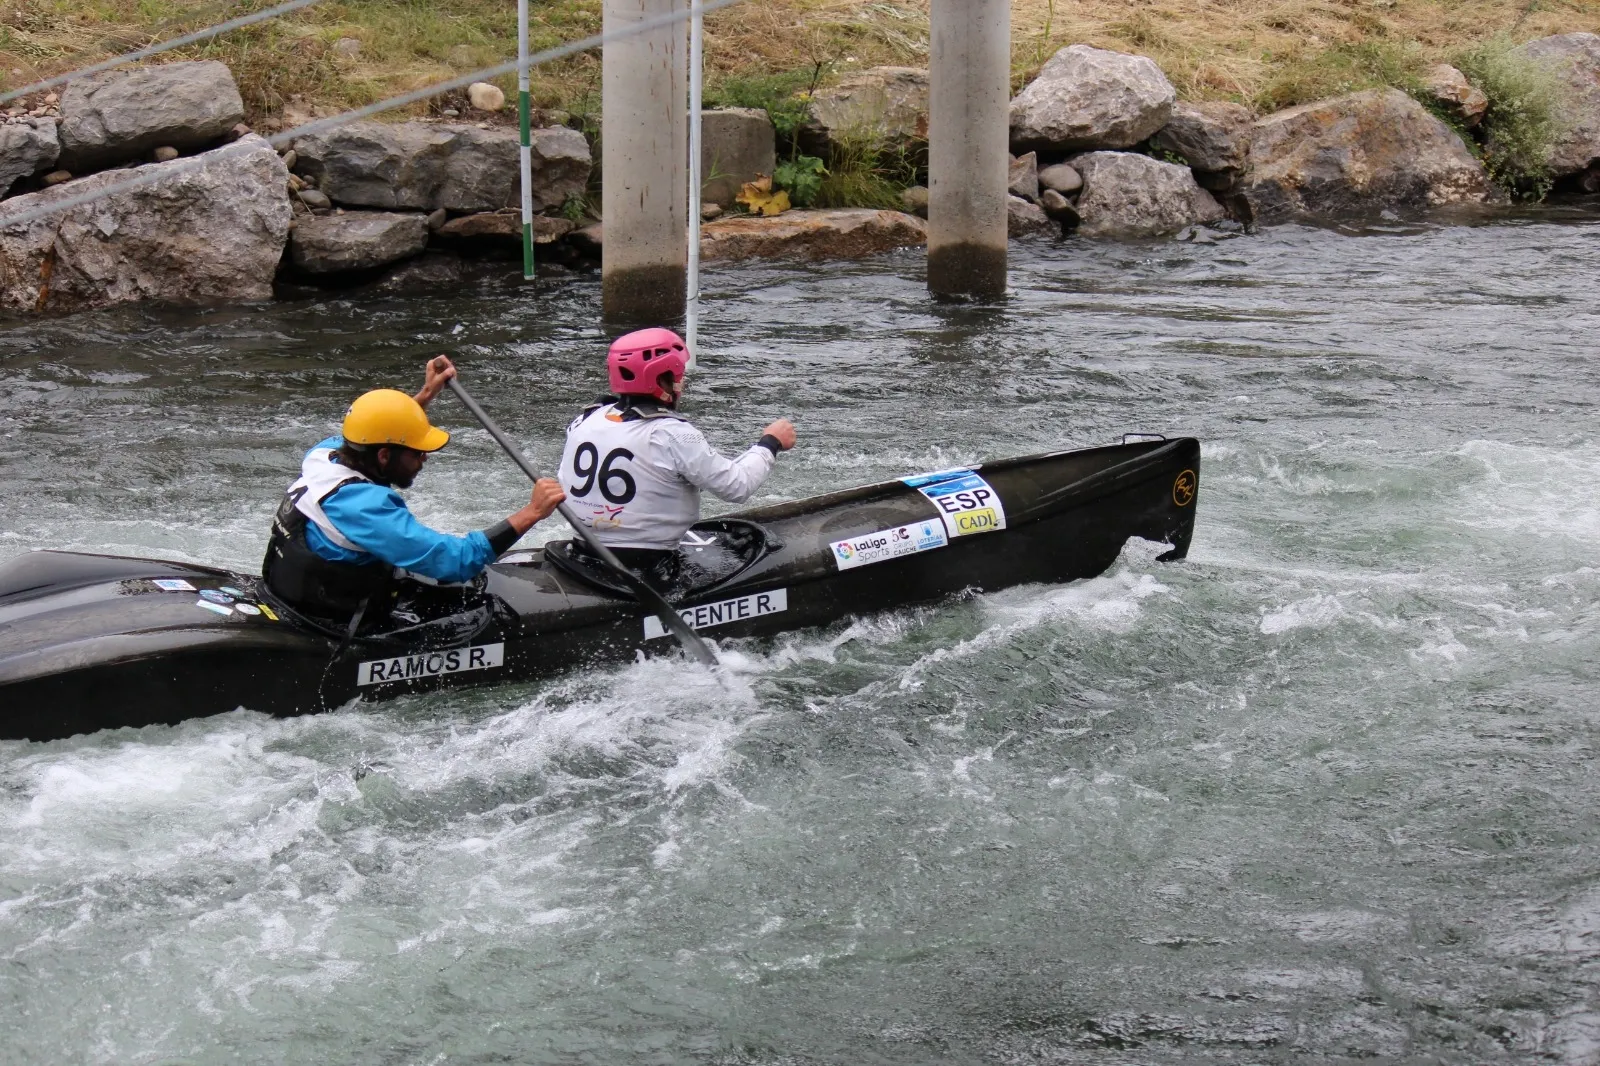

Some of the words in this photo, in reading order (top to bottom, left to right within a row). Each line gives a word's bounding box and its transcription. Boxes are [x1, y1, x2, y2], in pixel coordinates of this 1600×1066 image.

[570, 441, 637, 505] 96
[937, 488, 991, 514] ESP
[854, 537, 887, 551] LaLiga
[893, 540, 914, 550] GRUPO
[893, 546, 917, 556] CAUCHE
[858, 547, 890, 563] Sports
[757, 595, 777, 614] R.
[369, 650, 461, 682] RAMOS
[469, 648, 492, 668] R.
